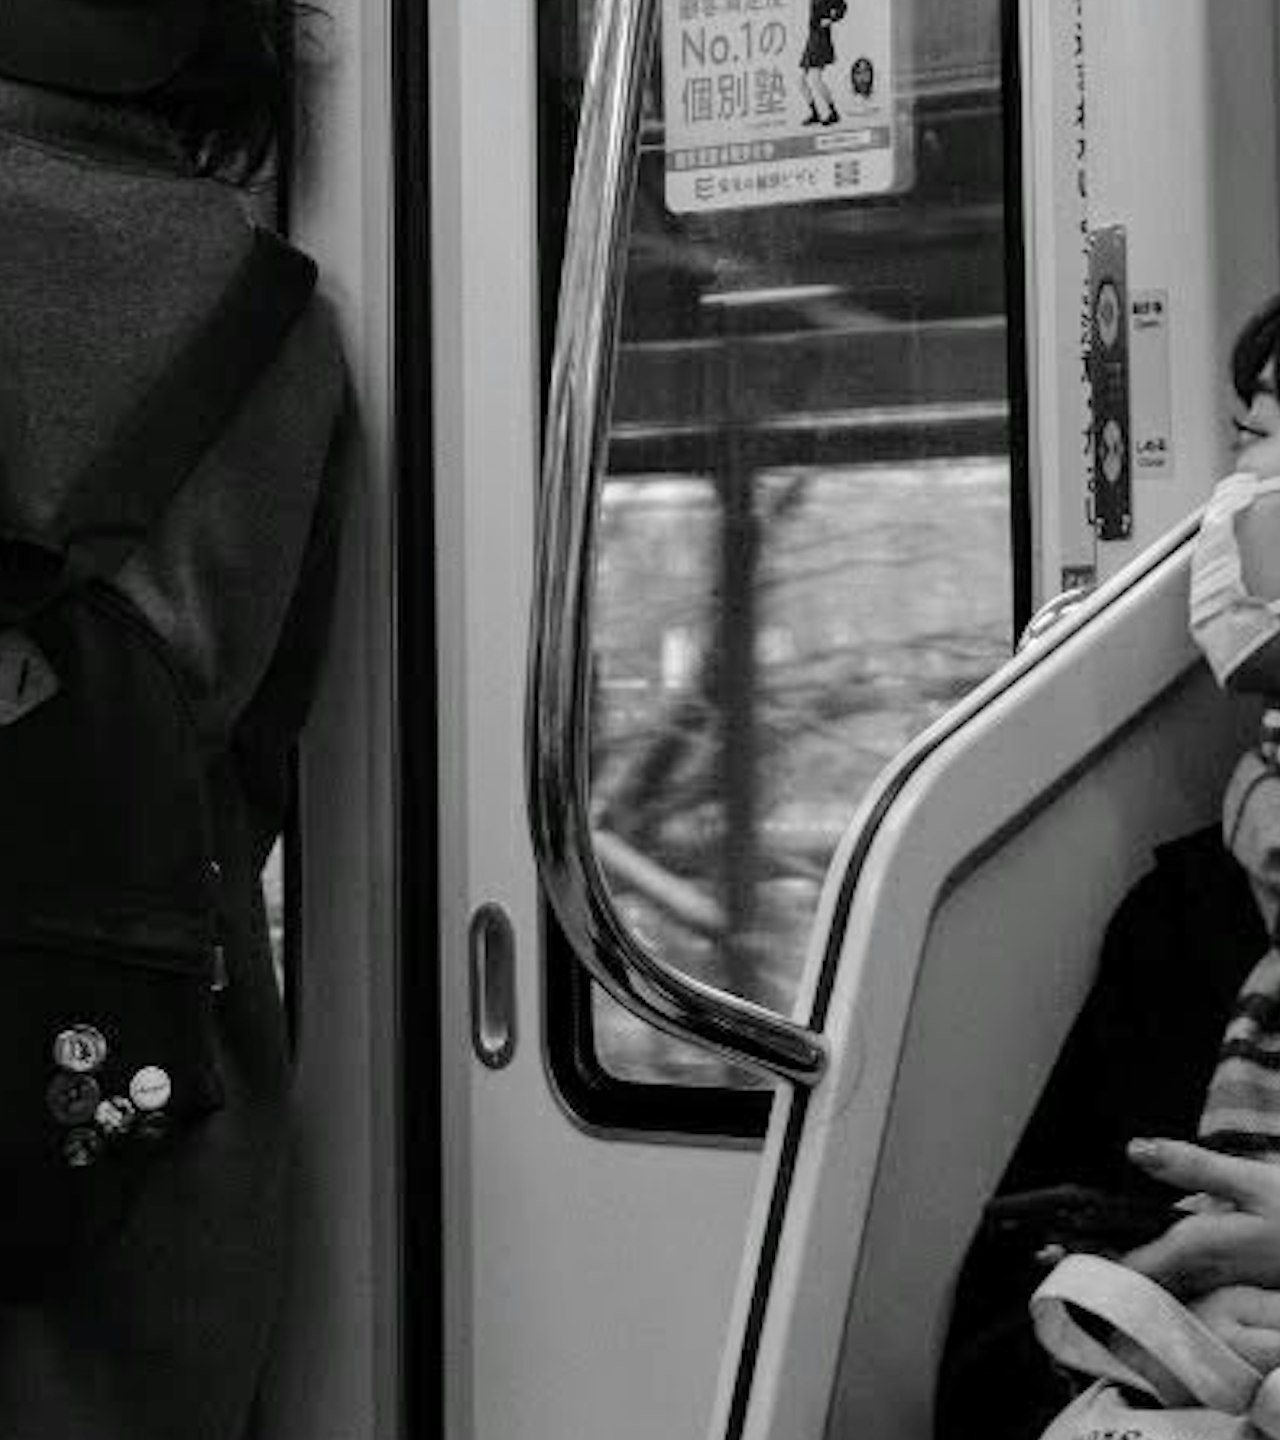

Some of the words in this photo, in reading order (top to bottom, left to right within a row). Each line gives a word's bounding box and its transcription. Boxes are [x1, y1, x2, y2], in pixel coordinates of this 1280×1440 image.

[681, 21, 787, 68] No.1の
[682, 68, 787, 126] 個別塾
